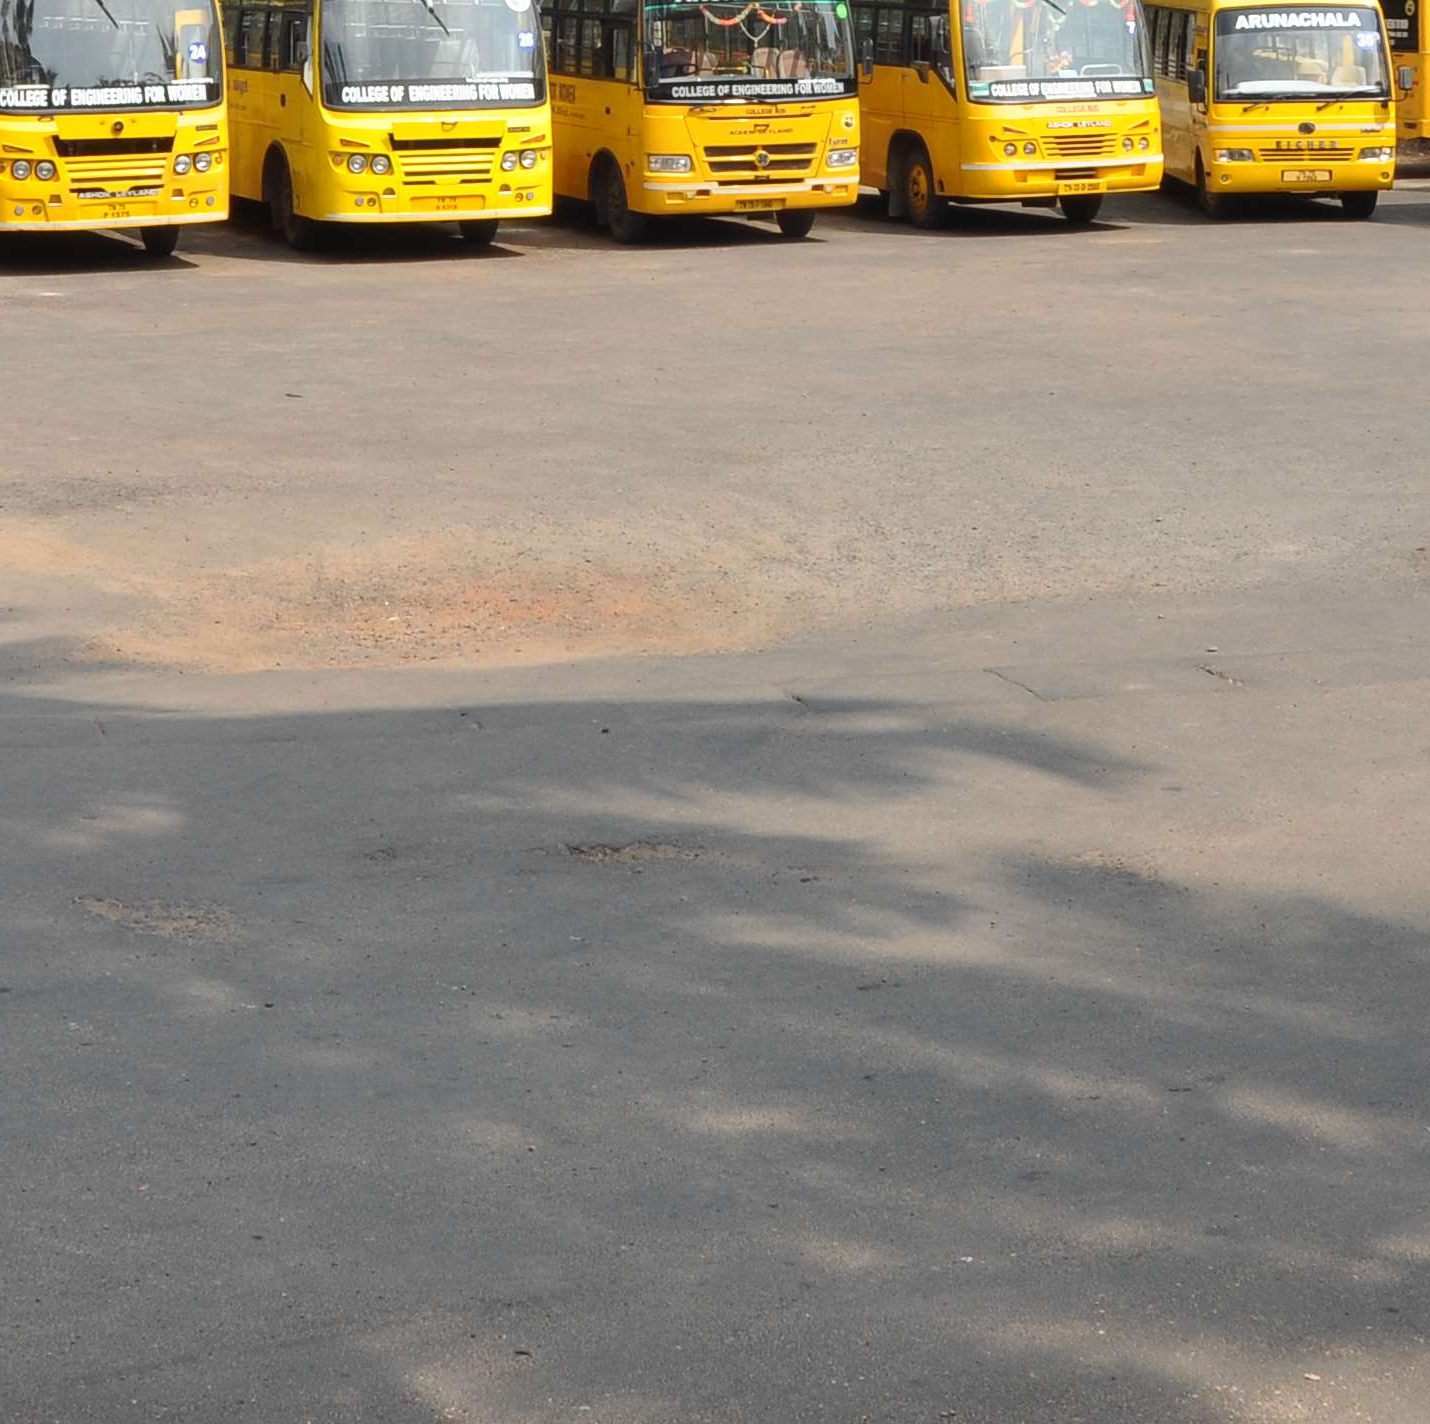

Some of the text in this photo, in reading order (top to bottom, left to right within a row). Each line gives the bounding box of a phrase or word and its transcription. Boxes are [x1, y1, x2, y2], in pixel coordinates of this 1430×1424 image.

[1235, 12, 1362, 30] ARUNACHALA
[0, 84, 207, 107] COLLEGE OF ENGINEERING FOR WOMEN
[342, 85, 389, 103] COLLEGE
[391, 85, 405, 102] OF
[409, 84, 478, 102] ENGINEERING
[479, 84, 500, 101] FOR
[501, 83, 535, 100] WOMEN
[672, 81, 845, 98] COLLEGE OF ENGINEERING FOR WOMEN
[991, 83, 1029, 97] COLLEGE
